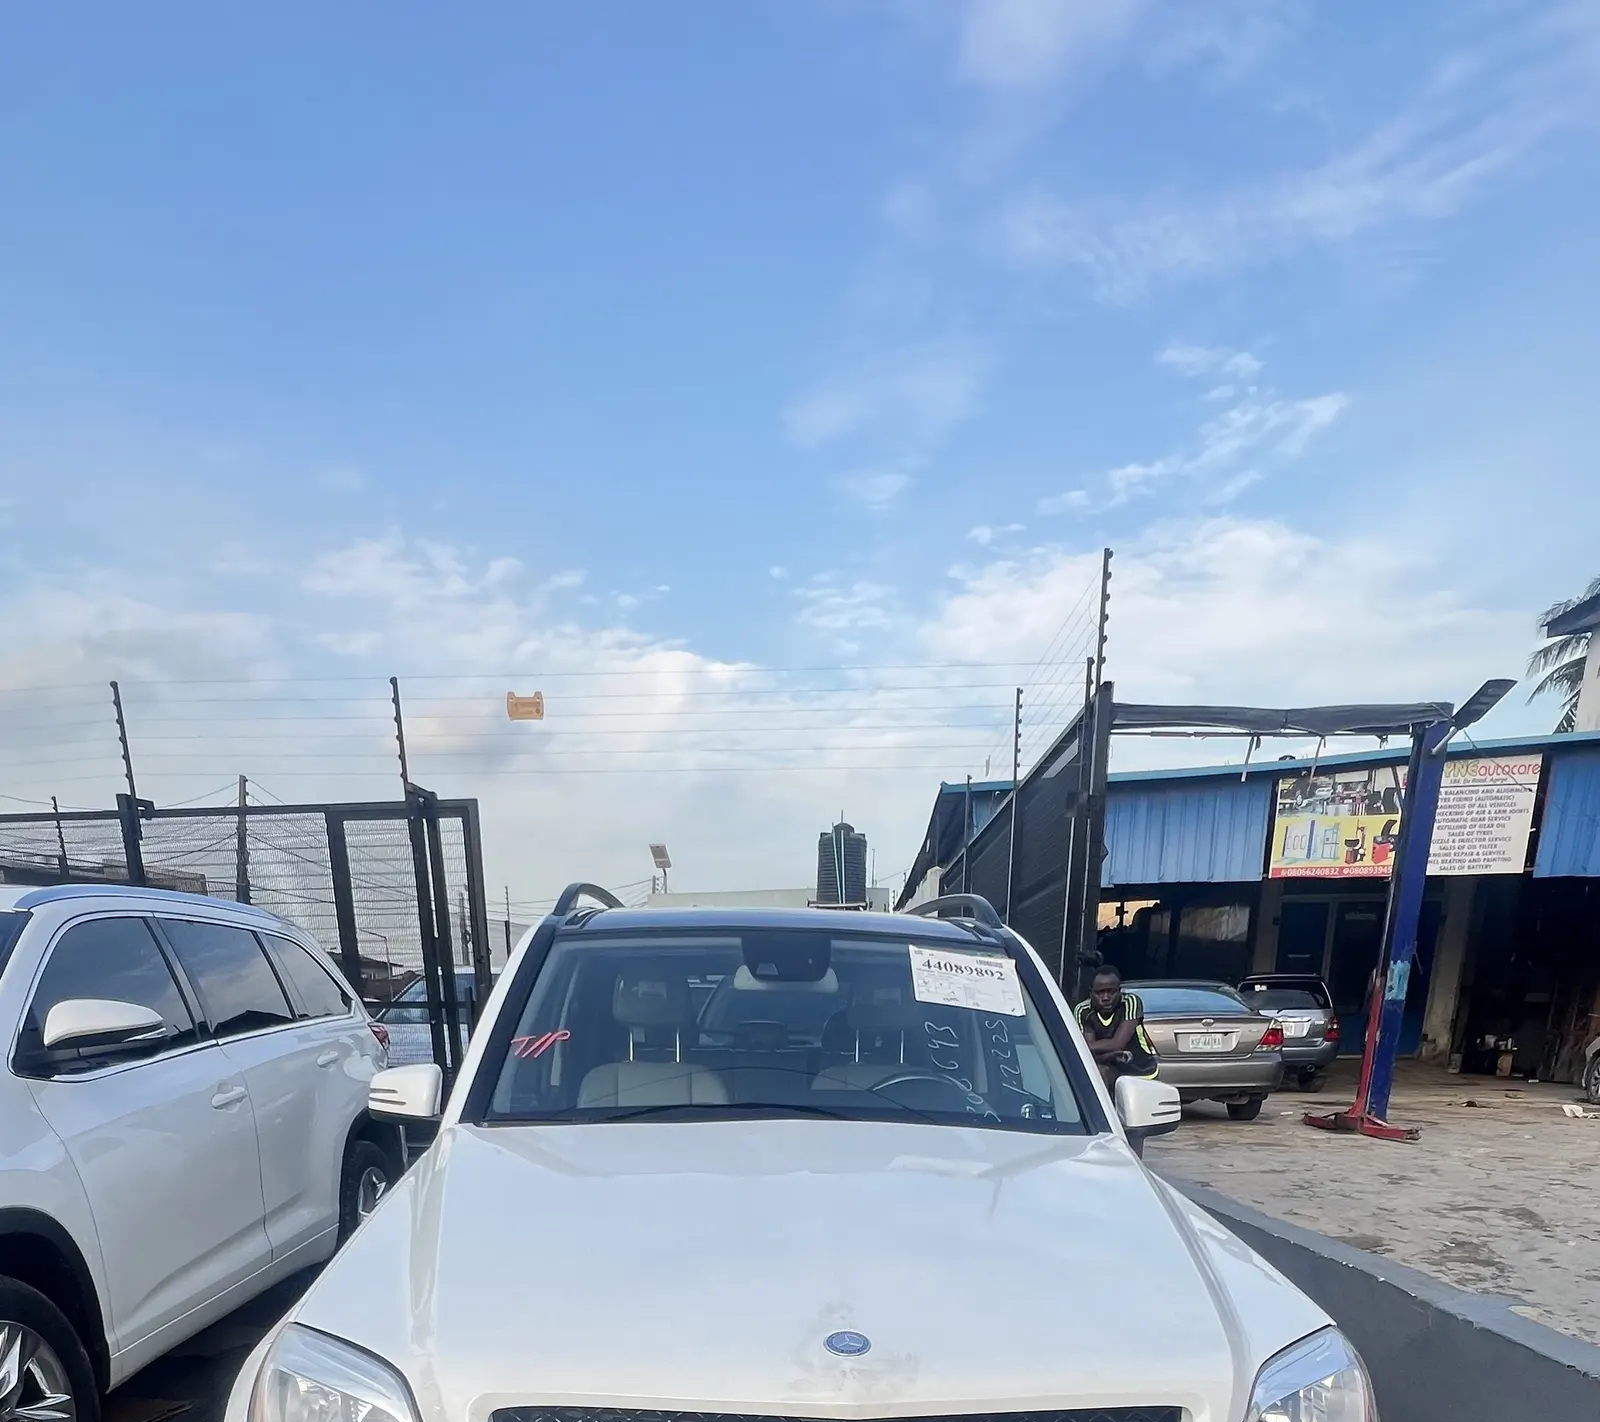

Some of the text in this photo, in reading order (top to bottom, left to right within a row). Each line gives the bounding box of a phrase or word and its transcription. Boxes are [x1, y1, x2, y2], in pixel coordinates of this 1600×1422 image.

[1481, 787, 1494, 795] AND
[1496, 786, 1532, 794] ALIGNMEN
[1431, 837, 1450, 845] OZZLE
[1457, 836, 1485, 844] INJECTOR
